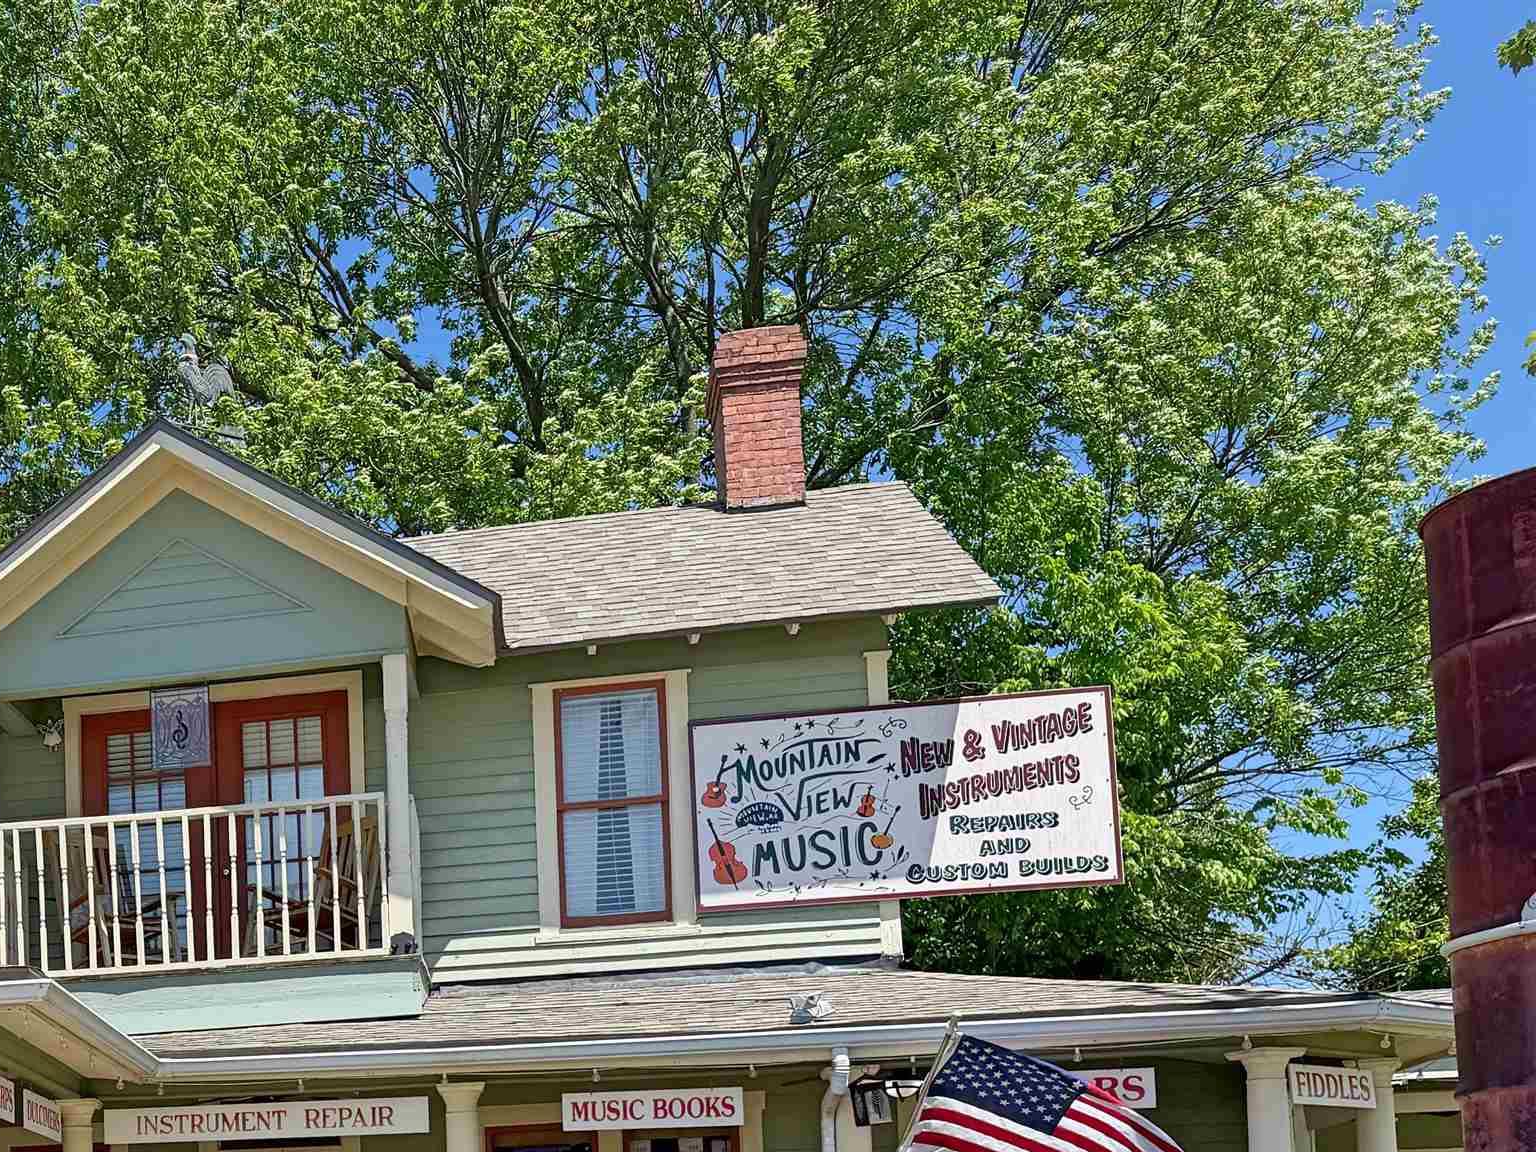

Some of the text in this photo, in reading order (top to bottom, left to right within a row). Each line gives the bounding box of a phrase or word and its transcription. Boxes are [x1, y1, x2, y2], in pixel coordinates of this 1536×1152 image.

[900, 702, 1093, 776] NEW & VINTAGE
[728, 739, 874, 801] MOUNTAIN
[918, 753, 1080, 819] INSTRUMENTS
[775, 780, 861, 821] VIEW
[949, 811, 1059, 834] REPAIRS
[752, 821, 884, 877] MUSIC
[978, 837, 1031, 857] AND
[905, 856, 1109, 883] CUSTOM BUILDS
[1294, 1070, 1371, 1102] FIDDLES
[136, 1105, 395, 1136] INSTRUMENT REPAIR
[570, 1095, 736, 1122] MUSIC BOOKS
